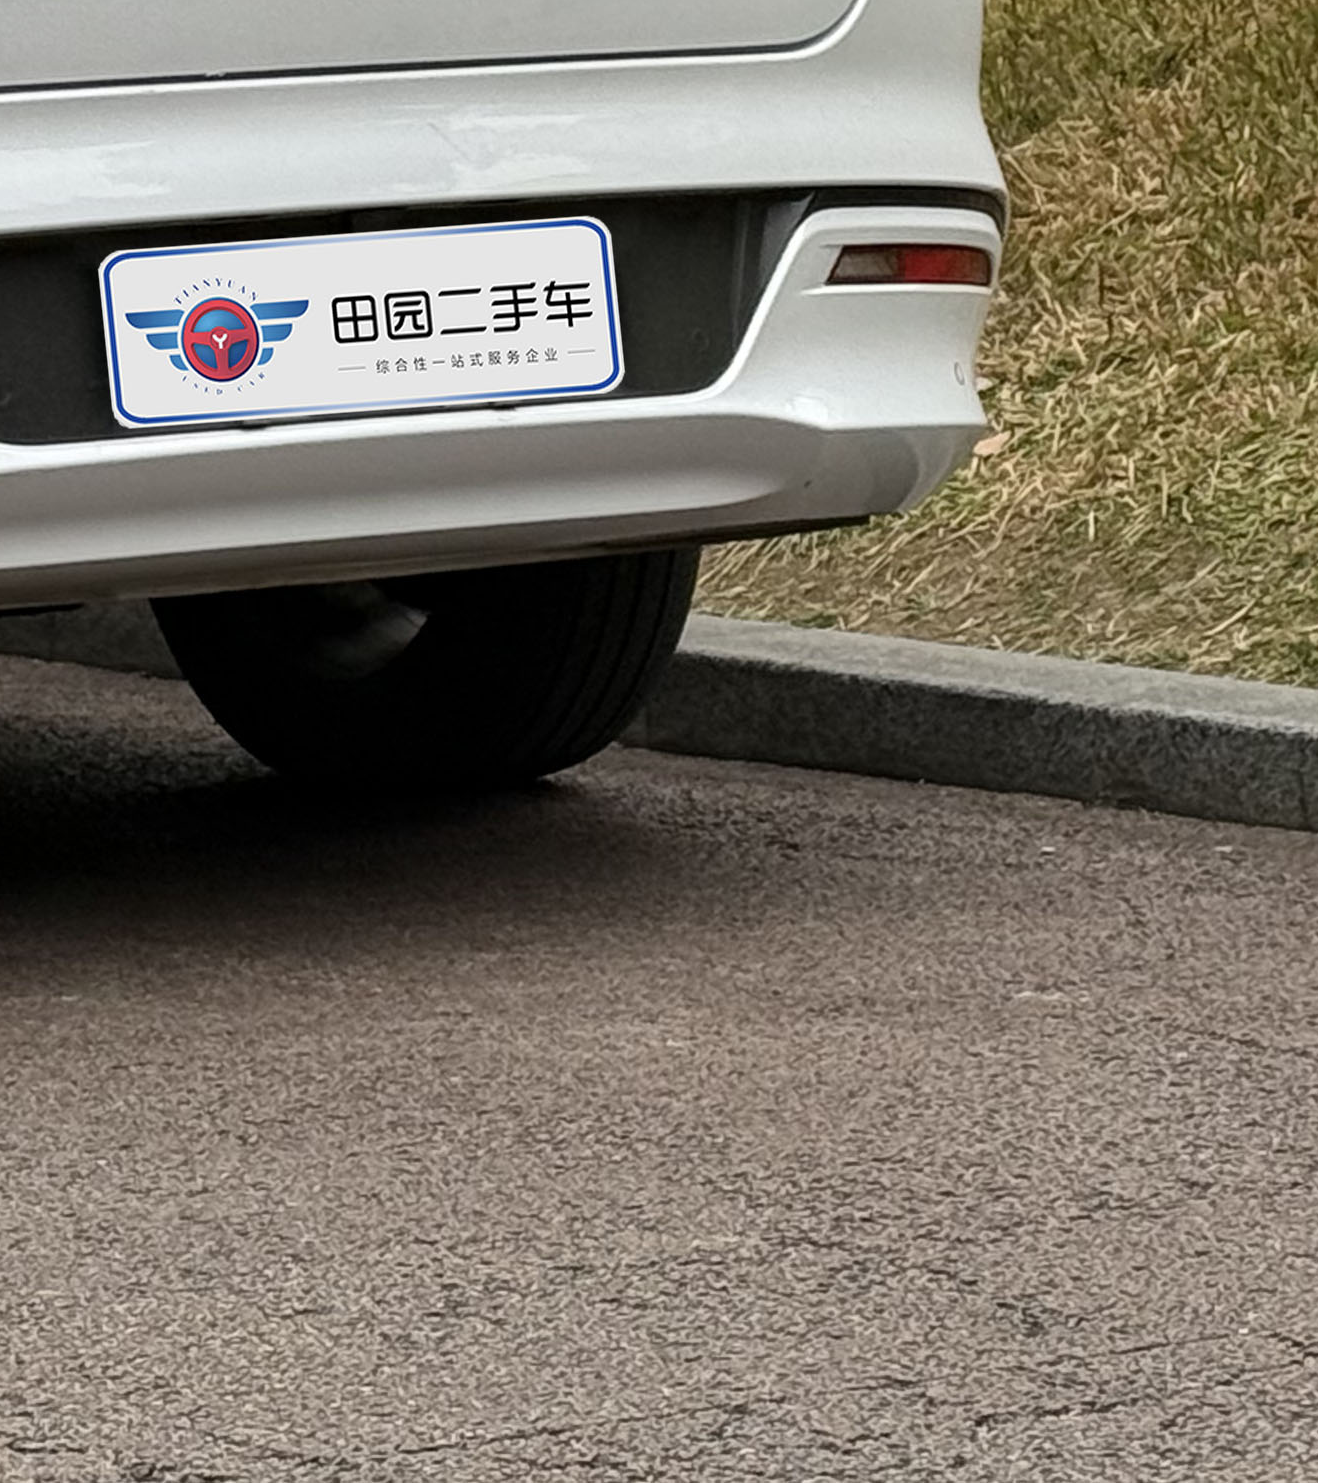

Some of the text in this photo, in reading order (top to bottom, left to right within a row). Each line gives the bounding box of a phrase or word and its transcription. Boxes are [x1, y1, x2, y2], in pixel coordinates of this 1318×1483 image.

[331, 280, 593, 344] 田园二手车
[375, 347, 559, 375] 综合性一站式服务企业
